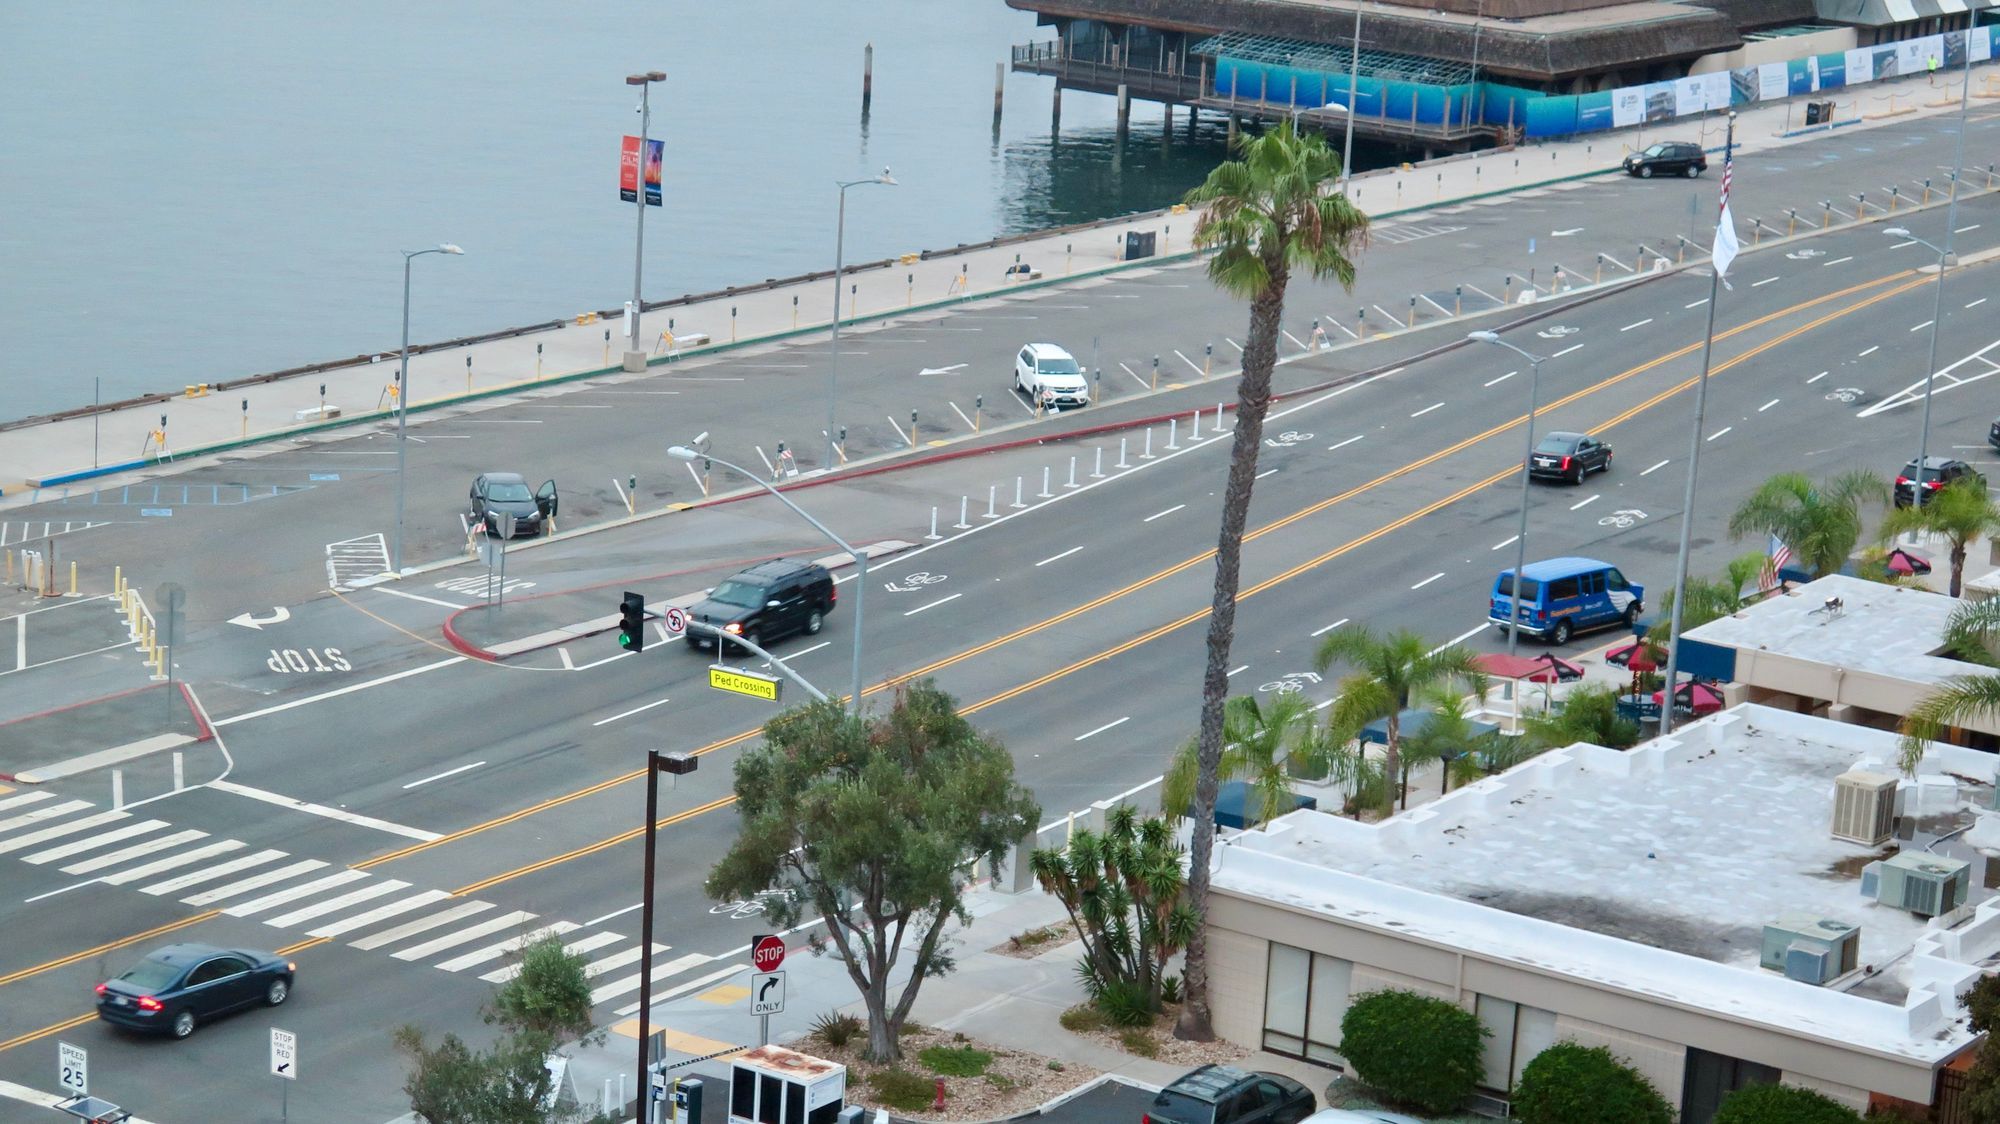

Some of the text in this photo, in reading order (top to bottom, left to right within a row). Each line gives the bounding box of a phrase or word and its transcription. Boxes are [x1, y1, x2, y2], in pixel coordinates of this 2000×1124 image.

[434, 573, 537, 598] STOP
[267, 648, 352, 673] STOP
[715, 674, 771, 697] Ped Crossing
[757, 946, 784, 963] STOP
[756, 1002, 780, 1012] ONLY
[274, 1032, 292, 1043] STOP
[62, 1047, 85, 1061] SPEED
[276, 1049, 290, 1059] RED
[65, 1056, 81, 1070] LIMIT
[63, 1067, 84, 1087] 25
